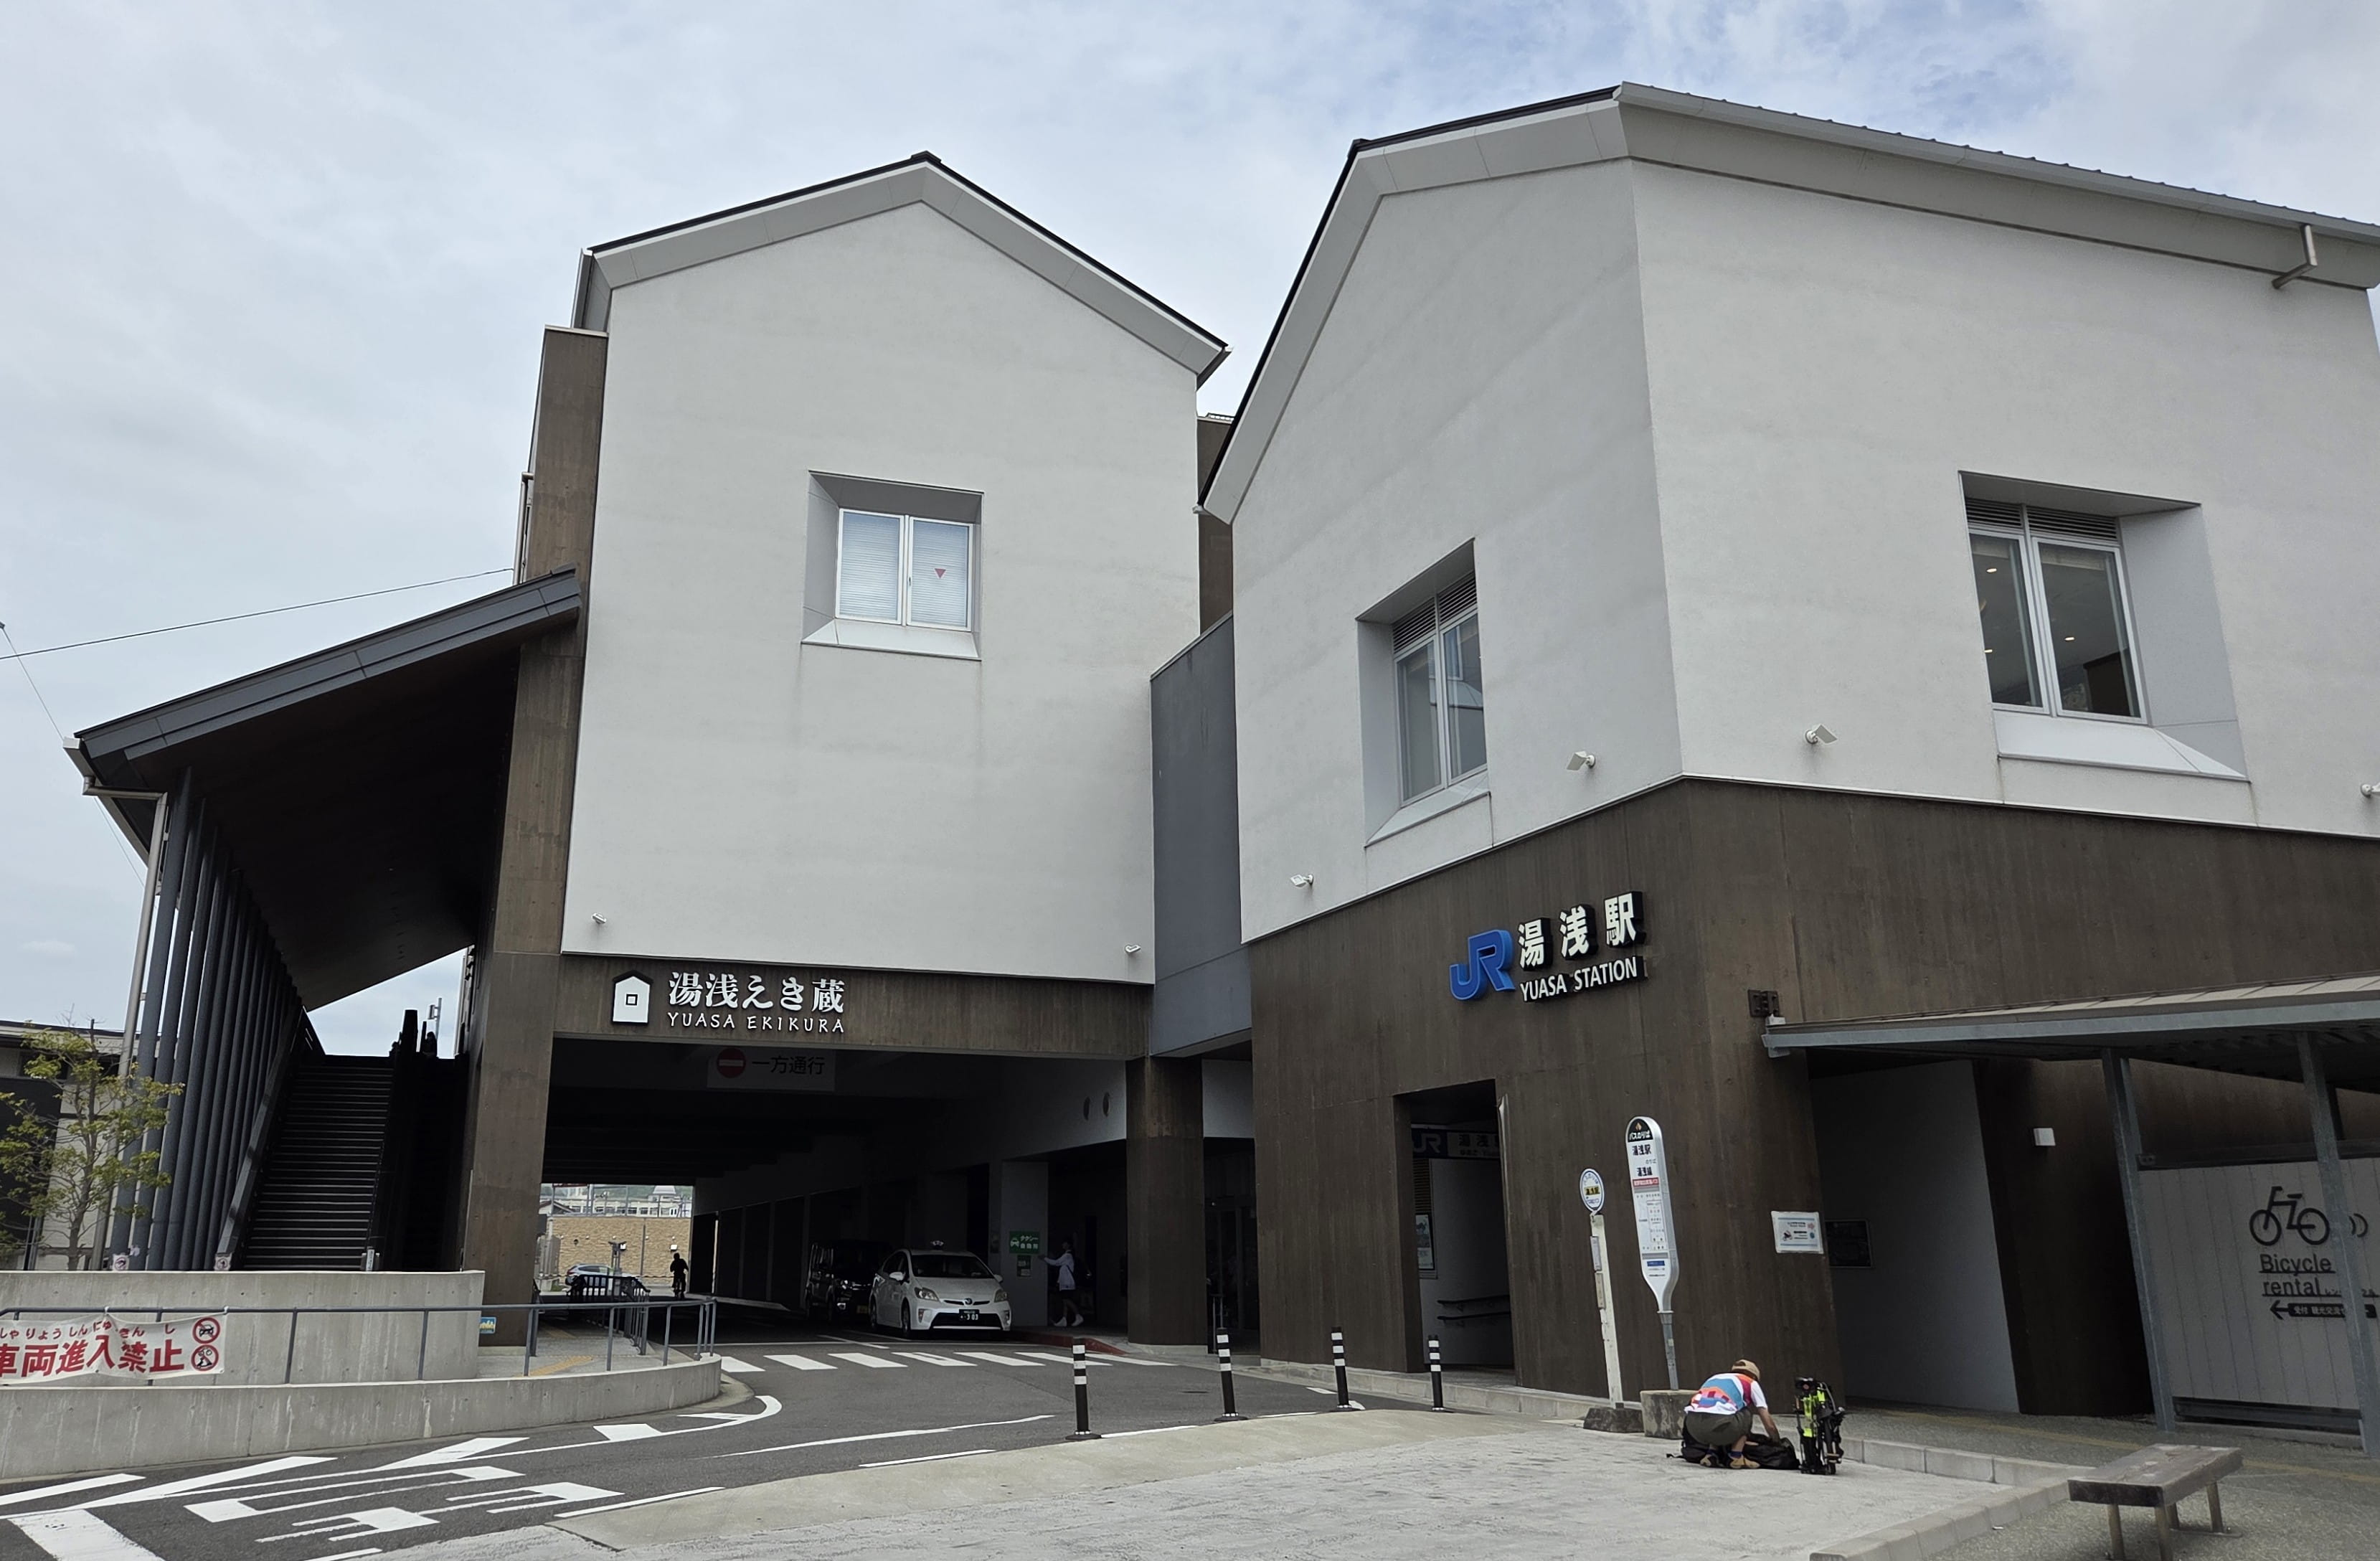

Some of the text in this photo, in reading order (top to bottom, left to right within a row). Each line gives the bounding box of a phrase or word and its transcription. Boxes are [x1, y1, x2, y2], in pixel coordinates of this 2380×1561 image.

[1518, 892, 1638, 969] 湯浅駅
[1449, 929, 1515, 1000] JR
[1519, 956, 1638, 1002] YUASA STATION
[669, 971, 845, 1014] 湯浅えき蔵
[667, 1011, 845, 1034] YUASA EKIKURA
[750, 1055, 826, 1075] 一方通行
[2259, 1253, 2332, 1276] Bicycle
[2262, 1277, 2320, 1296] rental
[0, 1335, 185, 1377] 車両進入禁止
